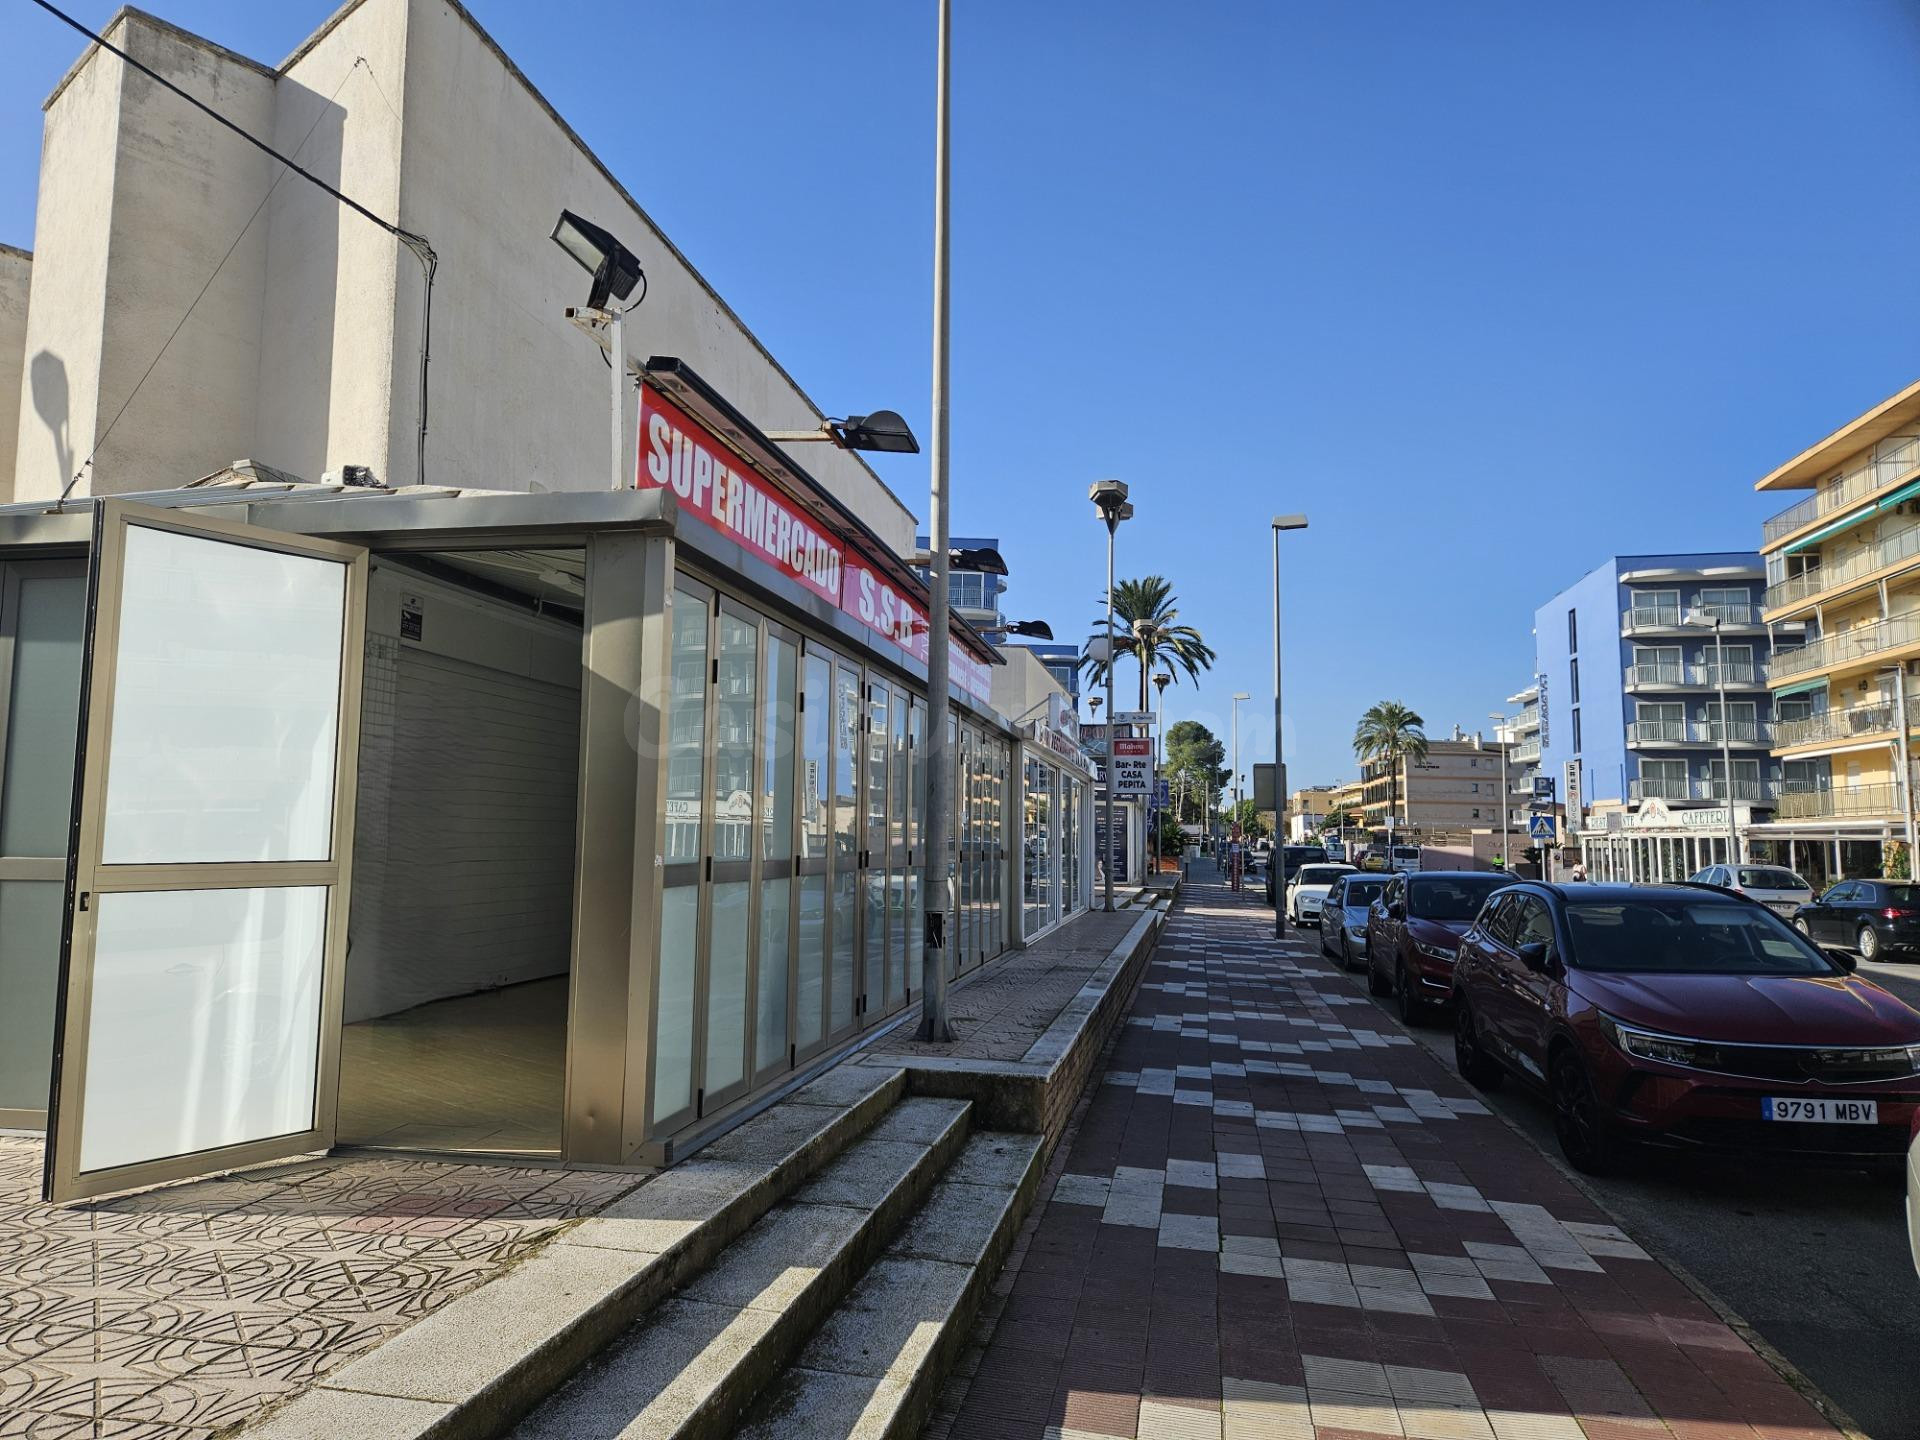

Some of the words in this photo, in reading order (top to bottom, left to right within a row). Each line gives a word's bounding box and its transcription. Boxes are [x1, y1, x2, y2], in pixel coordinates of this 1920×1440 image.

[647, 413, 839, 595] SUPERMERCADO
[1133, 760, 1147, 769] Rte
[1121, 771, 1143, 779] CASA
[1118, 780, 1146, 789] PEPITA
[1777, 1101, 1827, 1120] 9791
[1835, 1103, 1872, 1121] MBV
